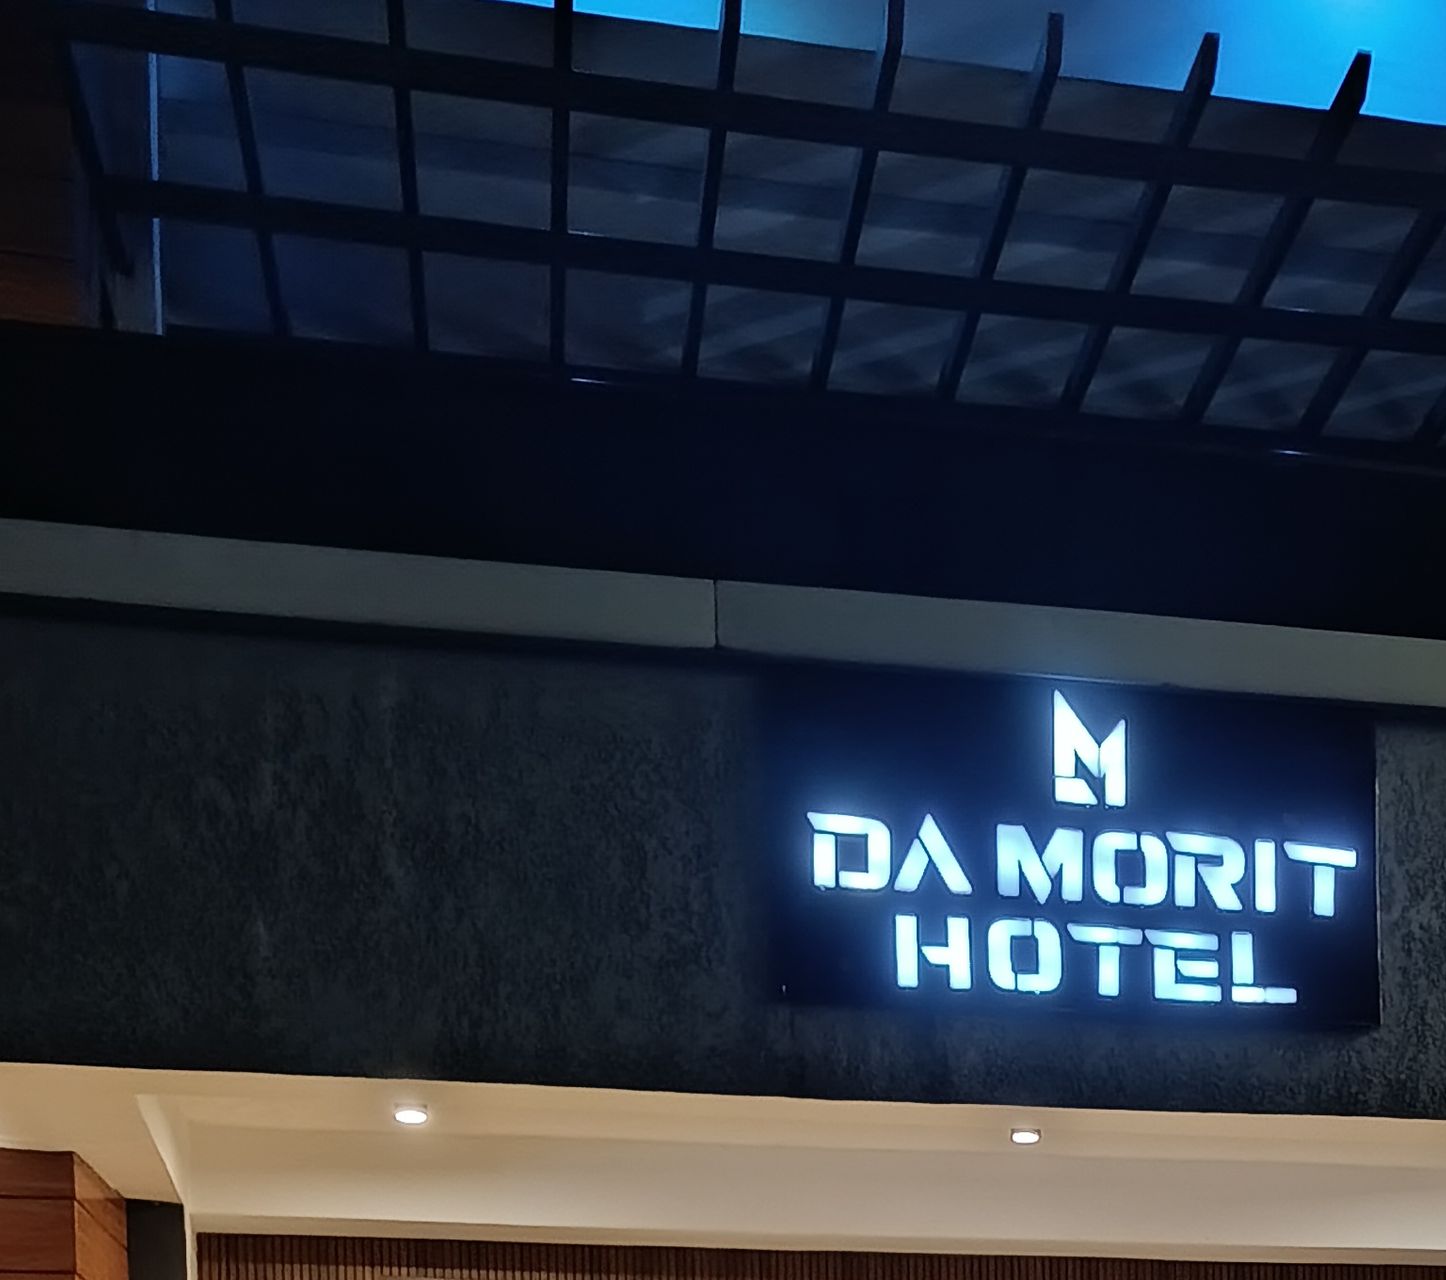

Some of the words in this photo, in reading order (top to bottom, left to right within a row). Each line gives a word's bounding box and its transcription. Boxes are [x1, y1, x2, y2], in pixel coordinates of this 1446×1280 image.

[805, 810, 974, 896] DA
[995, 821, 1359, 918] MORIT
[895, 913, 1298, 1005] HOTEL
